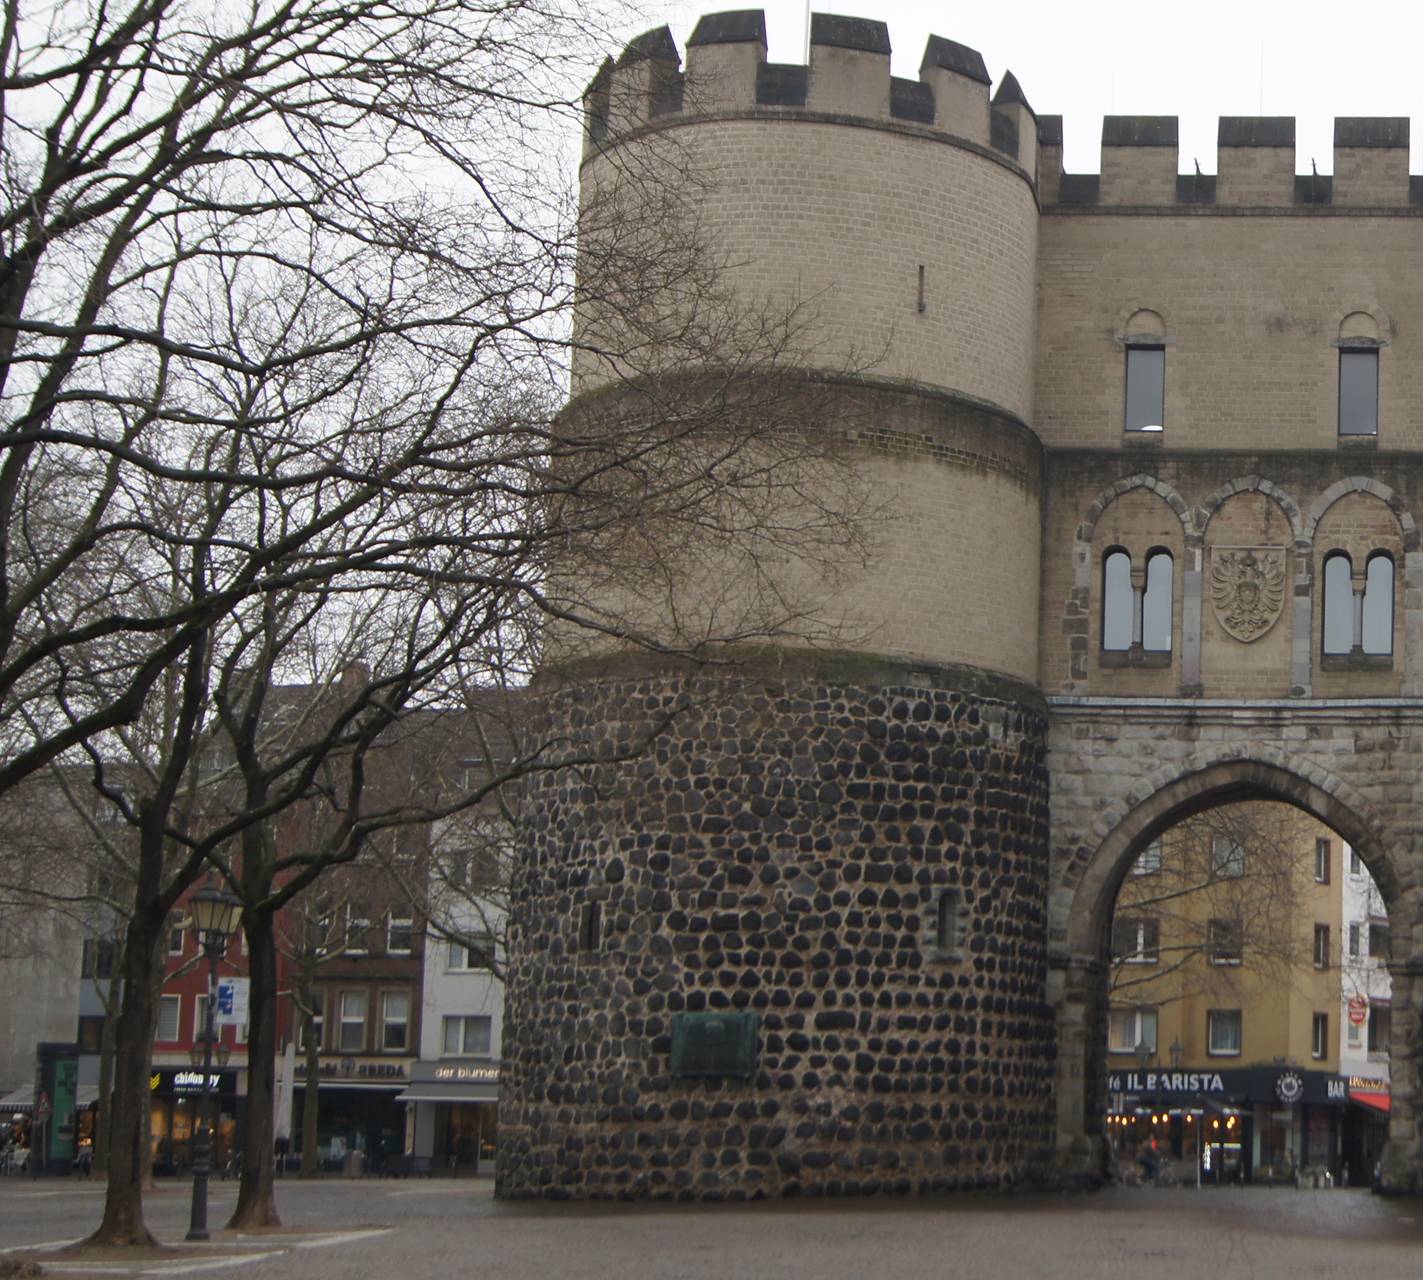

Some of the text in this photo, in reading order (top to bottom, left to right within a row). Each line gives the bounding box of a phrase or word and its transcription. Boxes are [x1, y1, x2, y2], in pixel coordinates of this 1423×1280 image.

[1127, 1073, 1143, 1090] IL
[1146, 1073, 1224, 1091] BARISTA
[1328, 1079, 1345, 1097] BAR
